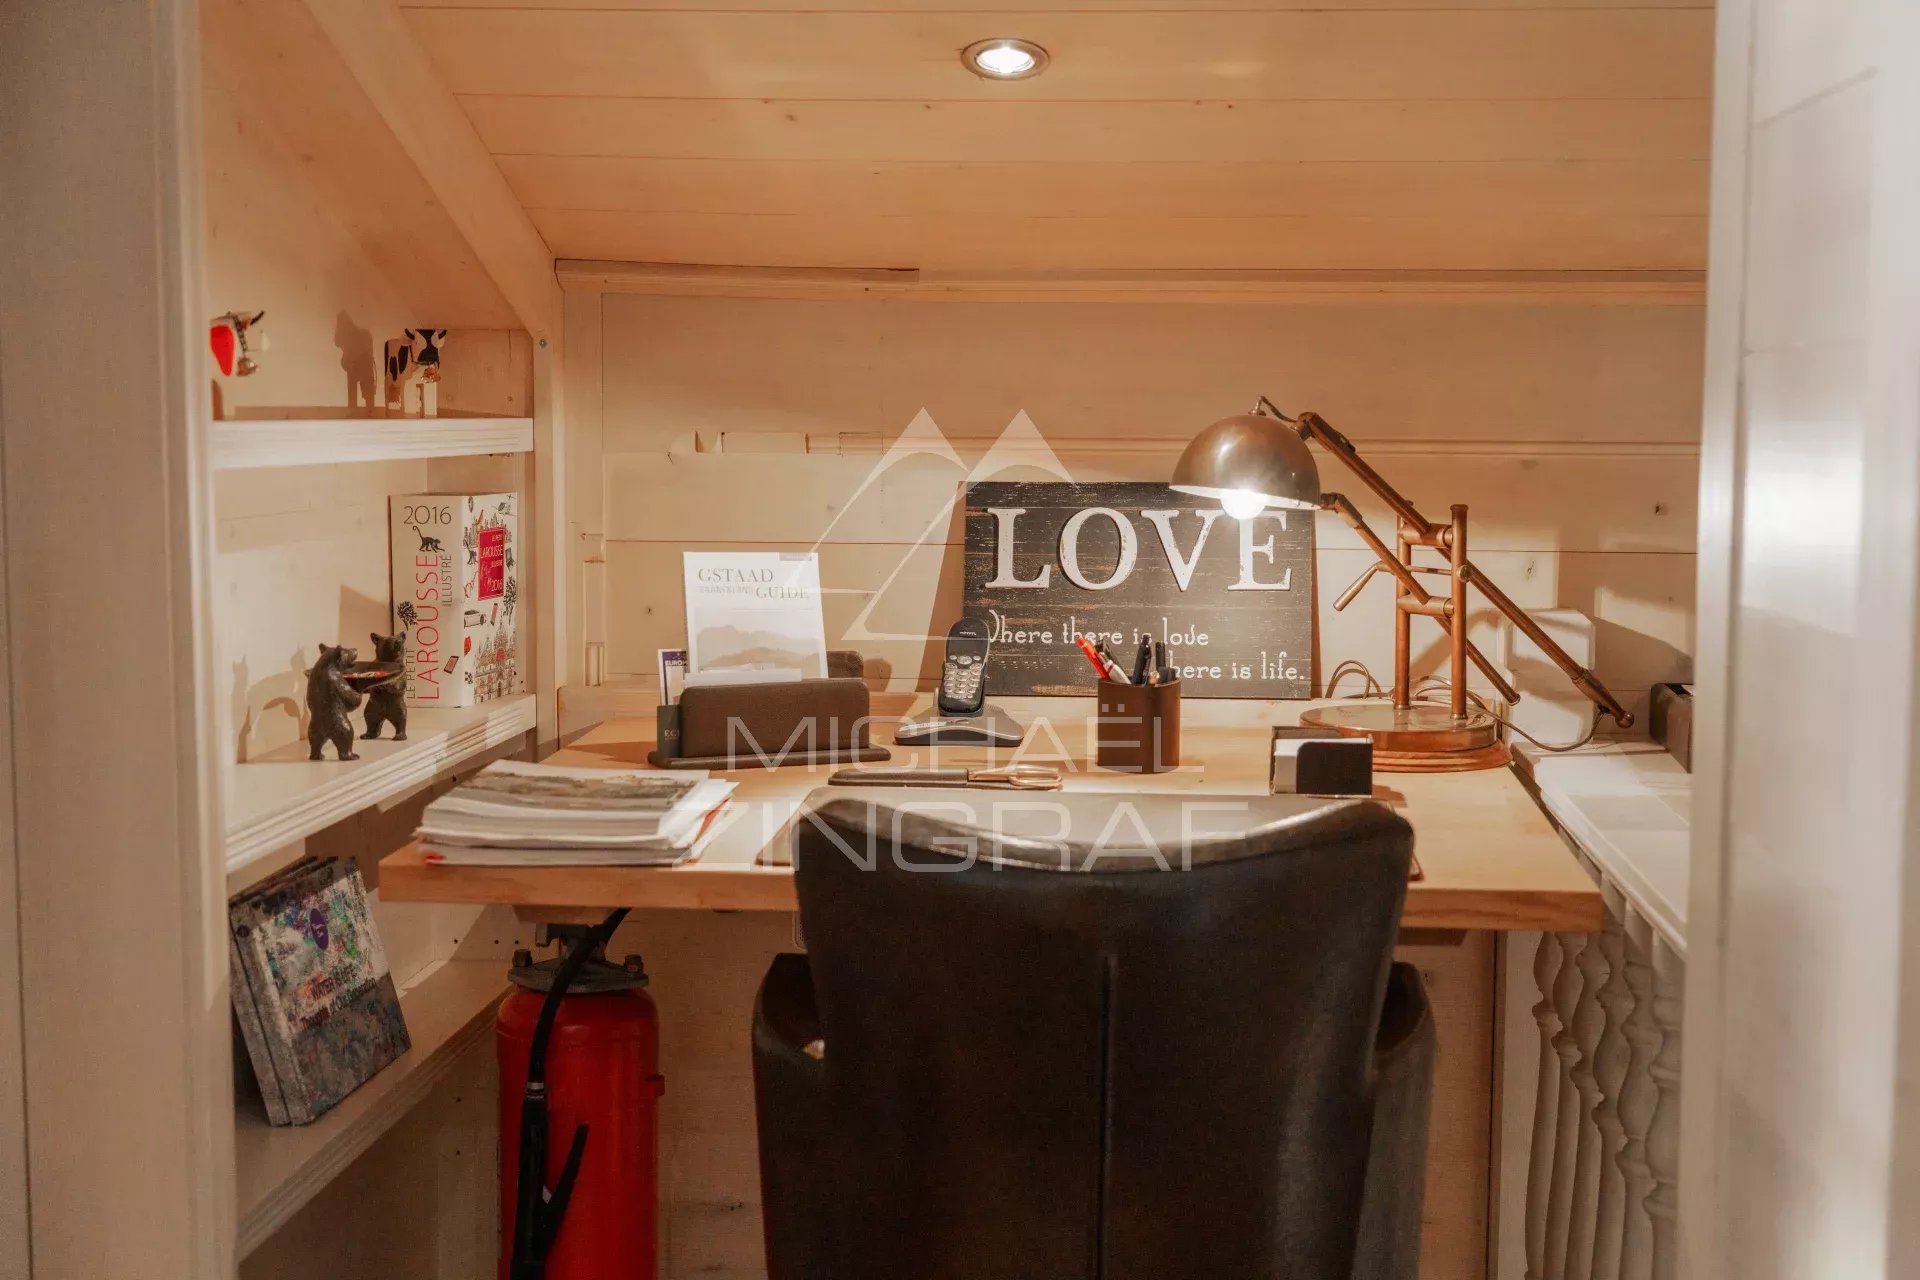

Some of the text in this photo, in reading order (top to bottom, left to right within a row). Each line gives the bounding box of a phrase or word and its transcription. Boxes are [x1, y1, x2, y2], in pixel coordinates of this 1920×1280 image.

[404, 505, 452, 525] 2016
[480, 545, 503, 558] LAROUSSE
[985, 507, 1292, 592] LOVE
[440, 554, 453, 607] ILLUSTRÉ
[698, 567, 774, 582] GSTAAD
[756, 586, 810, 600] GUIDE
[416, 554, 440, 699] LAROUSSE
[1162, 617, 1209, 646] love
[405, 648, 416, 699] LE PETIT
[1168, 650, 1304, 680] here is life.
